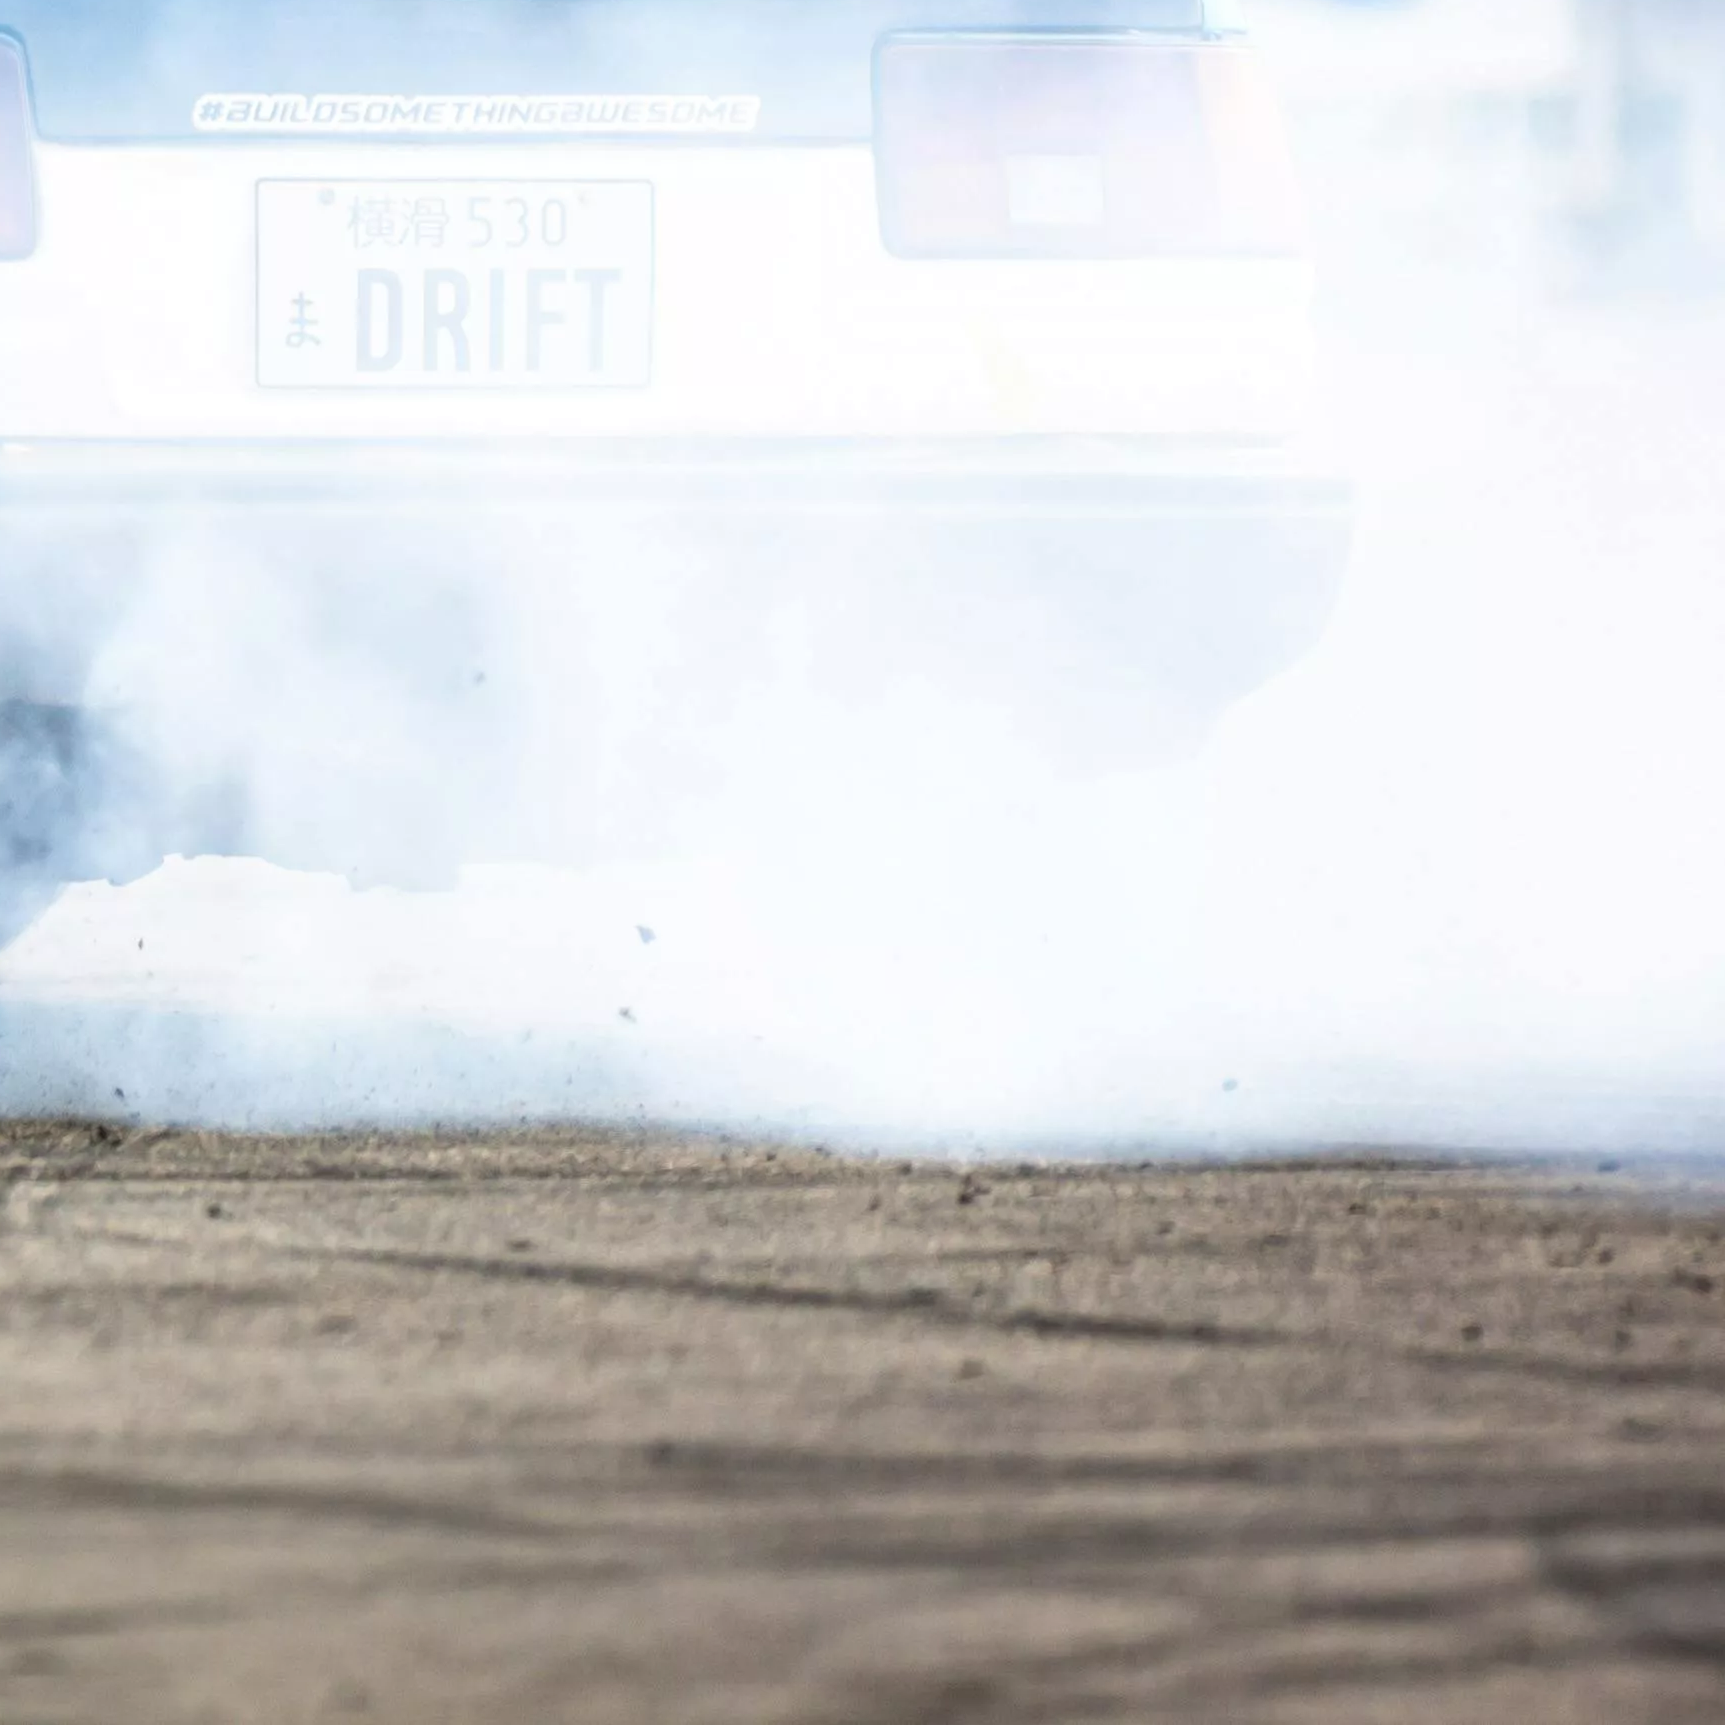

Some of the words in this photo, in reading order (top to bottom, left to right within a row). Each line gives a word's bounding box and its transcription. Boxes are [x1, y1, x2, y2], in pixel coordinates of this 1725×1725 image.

[466, 195, 568, 250] 530
[285, 290, 322, 348] ま
[355, 267, 623, 373] DRIFT
